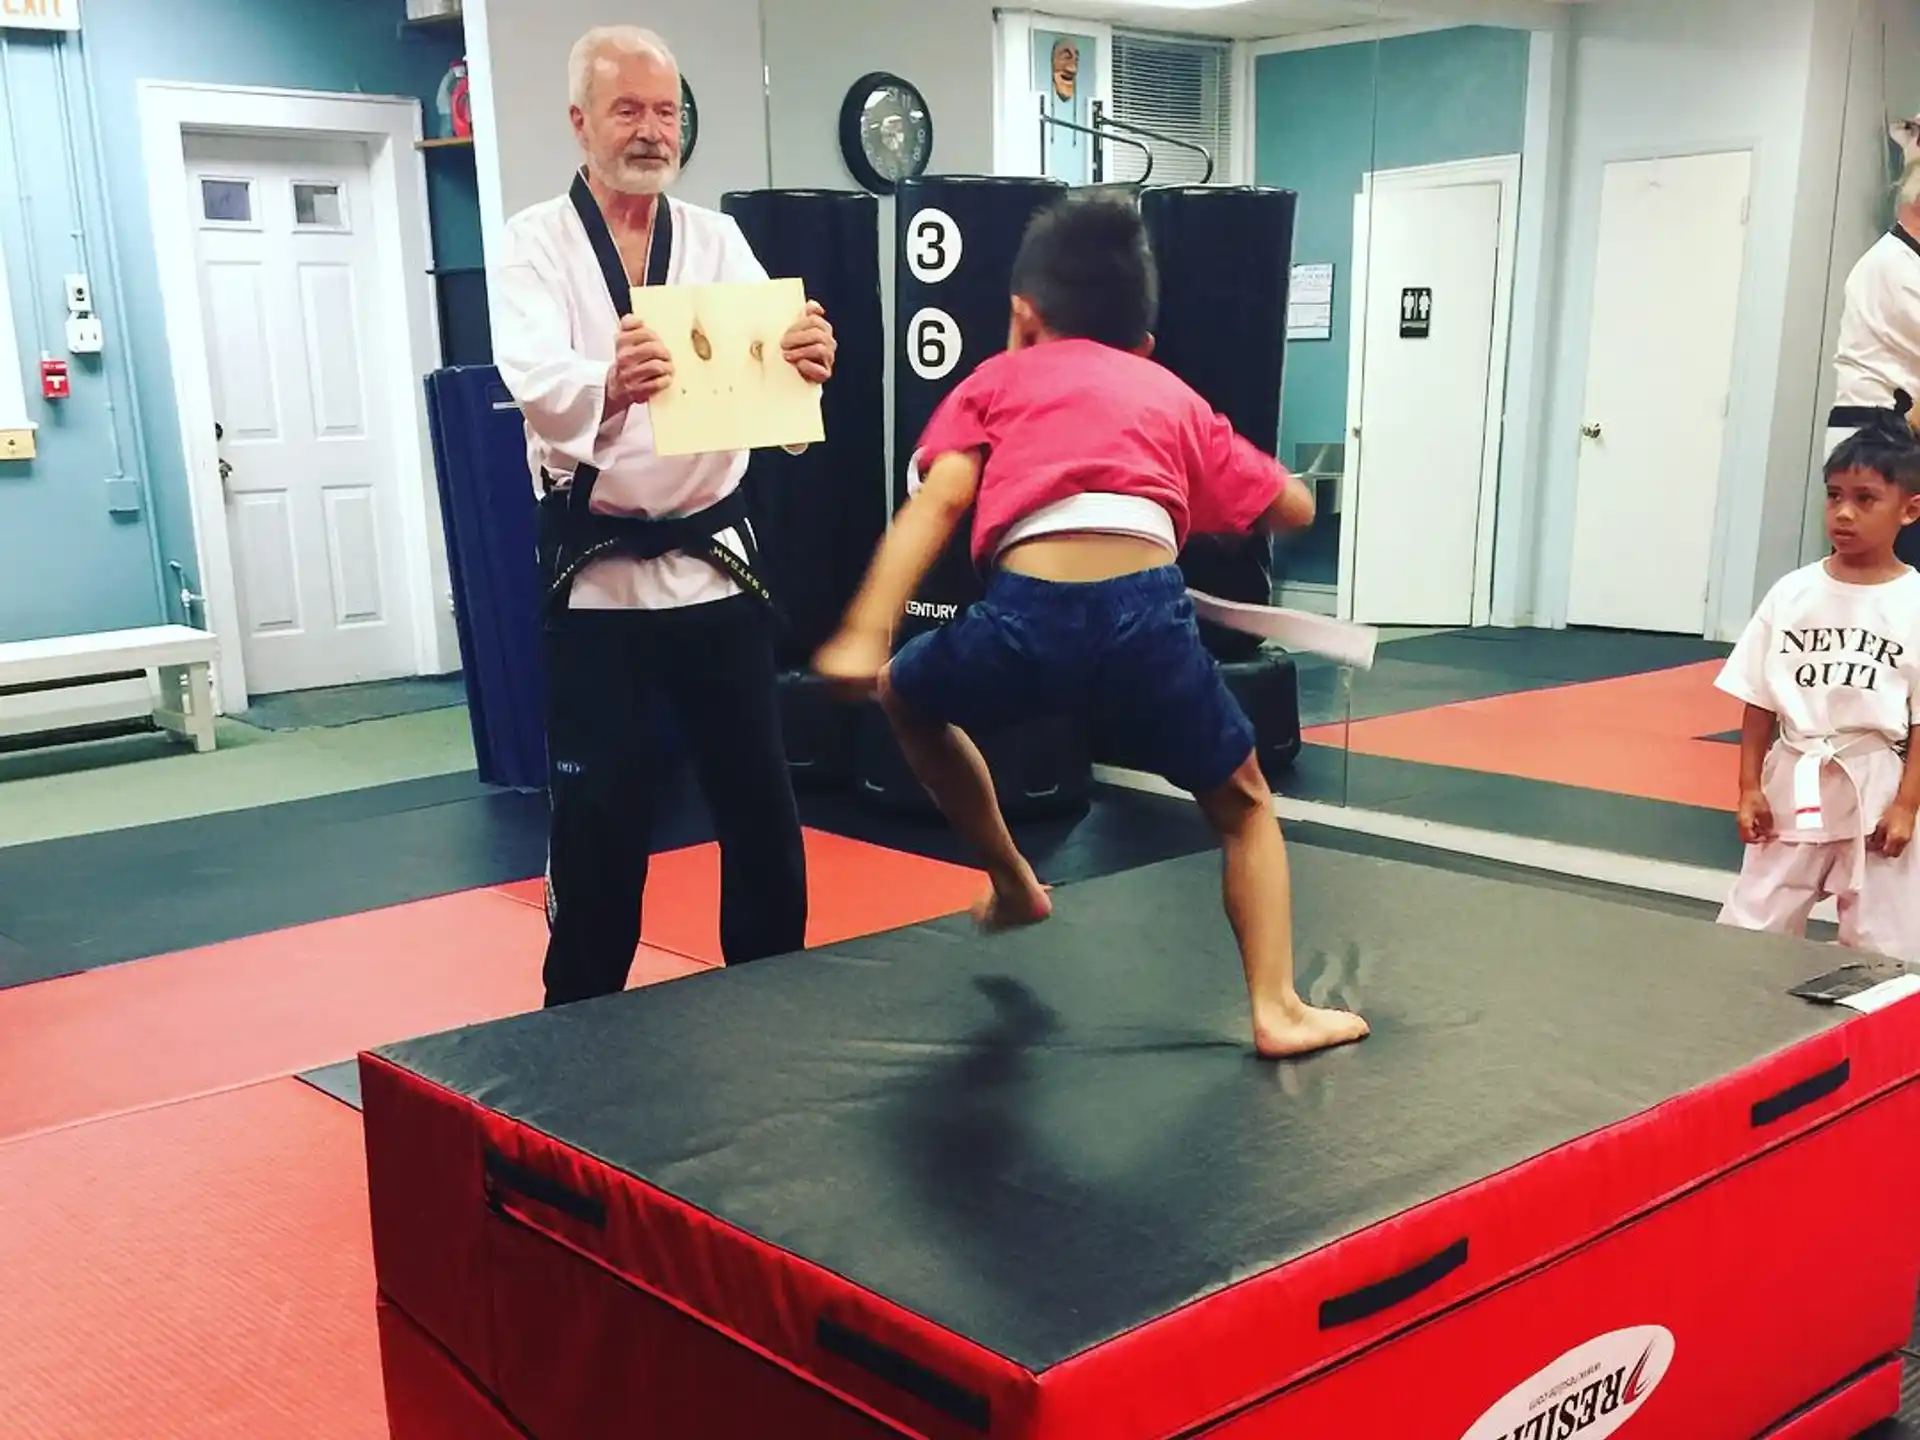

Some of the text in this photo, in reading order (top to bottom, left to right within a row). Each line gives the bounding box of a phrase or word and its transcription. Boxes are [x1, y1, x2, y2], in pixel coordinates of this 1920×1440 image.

[917, 221, 946, 270] 3
[917, 320, 946, 367] 6
[905, 600, 958, 619] CENTURY
[1780, 627, 1904, 669] NEVER
[1795, 661, 1877, 691] QUIT
